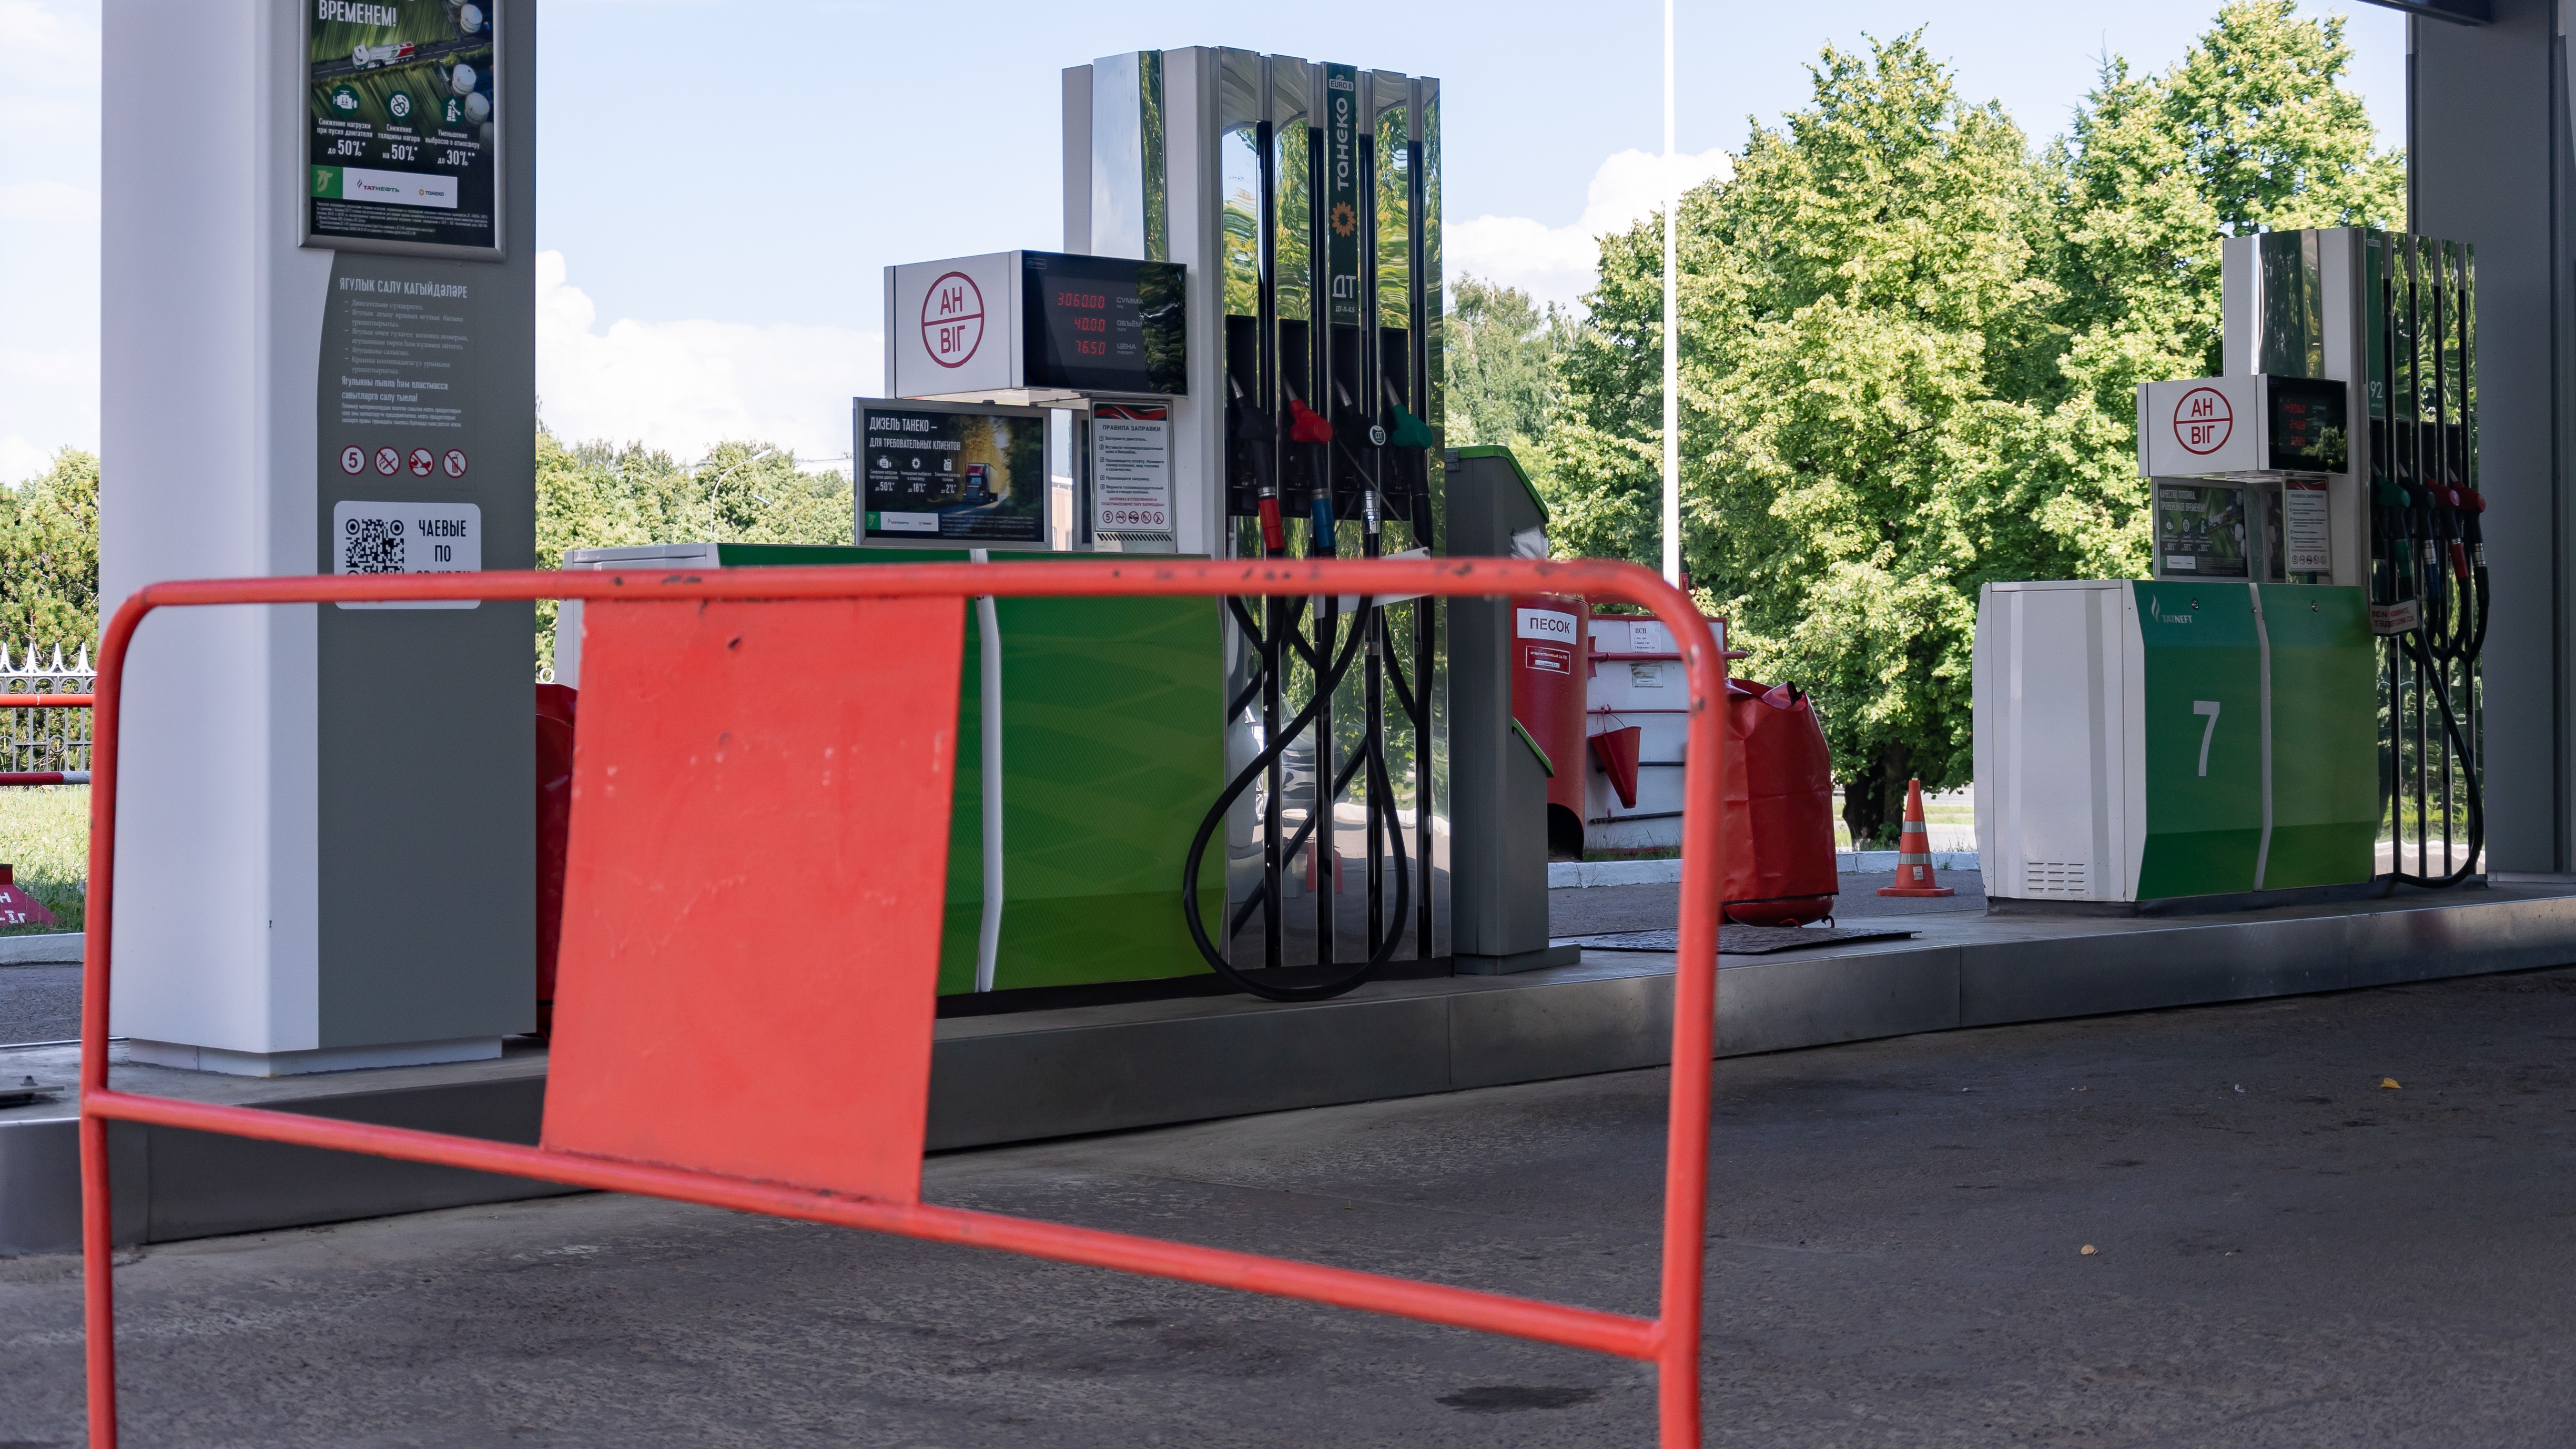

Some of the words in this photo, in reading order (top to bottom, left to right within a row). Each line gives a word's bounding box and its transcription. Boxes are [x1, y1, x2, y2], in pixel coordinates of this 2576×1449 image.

[319, 0, 396, 27] ВРЕМЕНЕМ!
[1330, 80, 1346, 89] EURO
[319, 118, 345, 127] Снижение
[387, 124, 412, 133] Снижение
[438, 129, 468, 138] Уменьшение
[425, 137, 449, 145] выбросов
[454, 140, 480, 150] атмосферу
[340, 278, 374, 292] ЯГУЛЫК
[378, 280, 401, 293] САЛУ
[404, 281, 467, 298] КАГЫЙДӘЛӘРЕ
[1332, 274, 1356, 299] ДТ
[940, 286, 963, 316] АН
[1074, 318, 1105, 332] 40.00
[342, 376, 373, 387] Ягулыкны
[397, 378, 409, 388] һәм
[411, 381, 448, 390] пластмасса
[2370, 380, 2383, 399] 92
[342, 392, 378, 402] савытларга
[380, 393, 394, 403] салу
[397, 393, 418, 402] тыела!
[2191, 398, 2213, 417] АН
[869, 417, 900, 431] ДИЗЕЛЬ
[902, 419, 929, 432] ТАНЕКО
[869, 437, 882, 448] ДЛЯ
[883, 438, 931, 450] ТРЕБОВАТЕЛЬНЫХ
[932, 441, 960, 451] КЛИЕНТОВ
[348, 452, 358, 468] 5
[418, 519, 466, 537] ЧАЕВЫЕ
[434, 545, 451, 562] ПО
[1530, 617, 1570, 634] ПЕСОК
[2162, 615, 2192, 623] TATNEFT
[2193, 700, 2220, 777] 7
